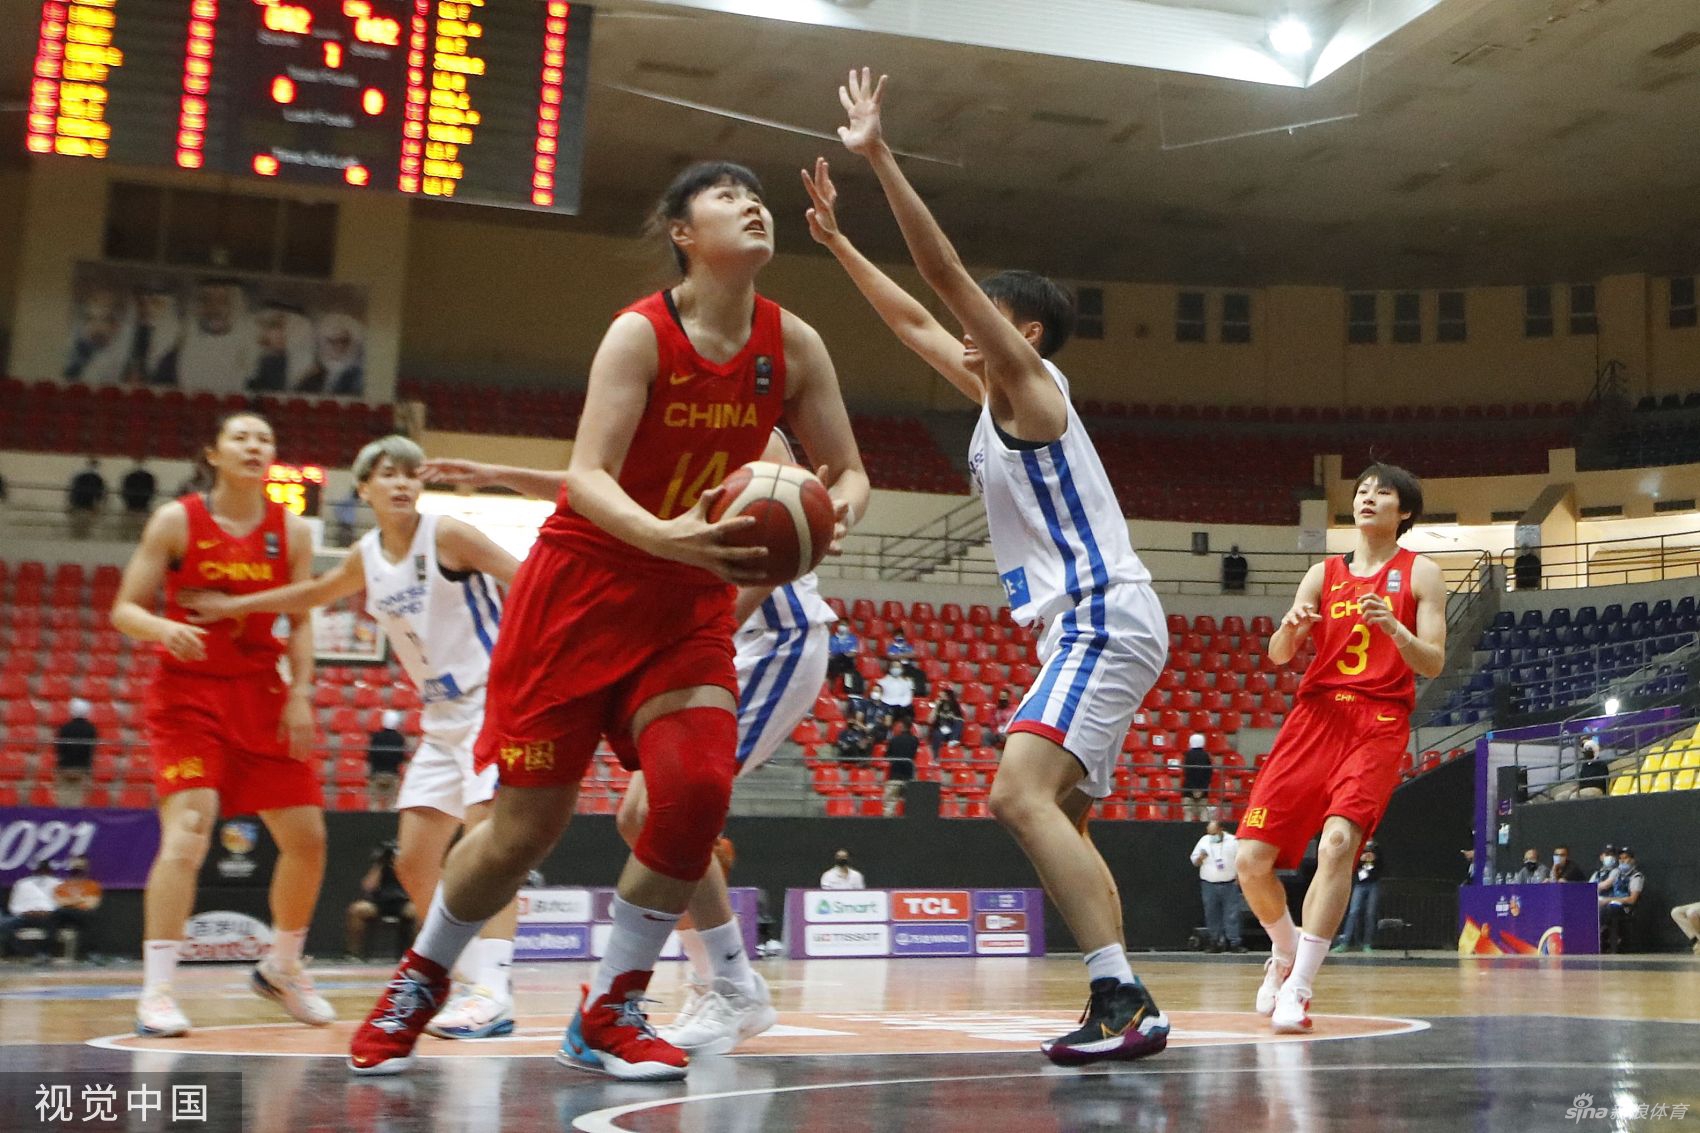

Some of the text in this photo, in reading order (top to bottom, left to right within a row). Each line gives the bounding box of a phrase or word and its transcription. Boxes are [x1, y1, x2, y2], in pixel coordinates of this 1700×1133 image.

[664, 402, 758, 428] CHINA
[659, 452, 728, 519] 14
[199, 561, 272, 581] CHINA
[1331, 595, 1393, 619] CHA
[1336, 624, 1370, 675] 3
[833, 901, 878, 914] Smart
[903, 898, 959, 915] TCL
[832, 932, 880, 942] TISSOT
